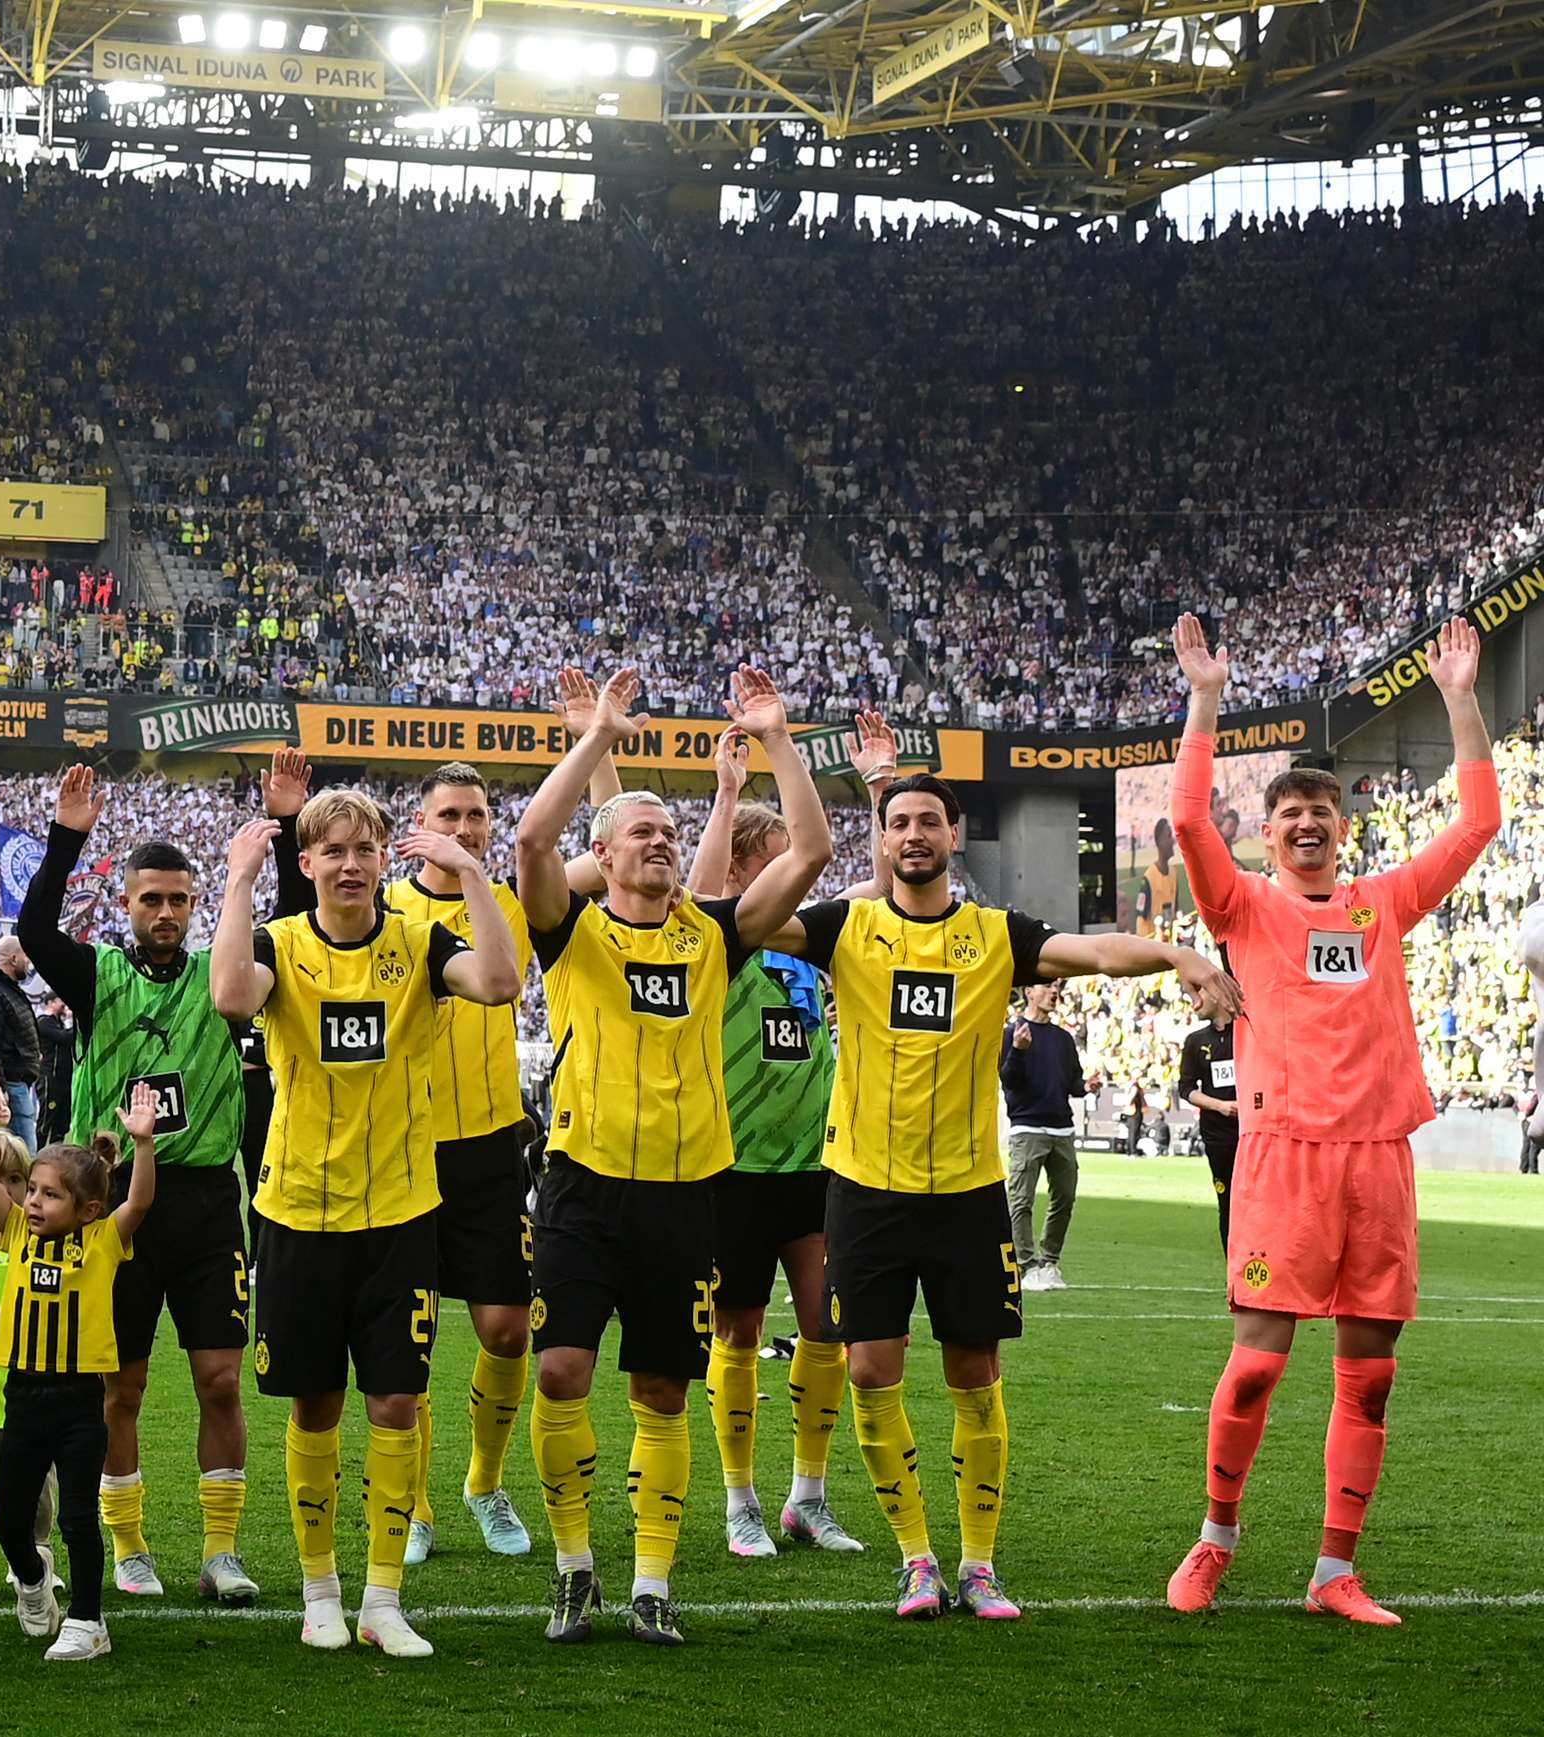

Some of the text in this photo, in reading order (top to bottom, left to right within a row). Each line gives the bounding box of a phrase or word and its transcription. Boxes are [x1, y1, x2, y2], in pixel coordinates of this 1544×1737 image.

[877, 18, 984, 91] SIGNAL IDUNA PARK
[103, 51, 377, 89] SIGNAL IDUNA PARK
[9, 499, 44, 520] 71
[326, 717, 749, 759] DIE NEUE BVB-EON 205
[1009, 719, 1306, 769] BORUSSIA DTMUND
[675, 935, 699, 953] BVB
[954, 944, 978, 960] BVB
[1313, 946, 1357, 972] 1&1
[380, 962, 406, 981] BVB
[629, 974, 680, 1006] 1&1
[897, 984, 947, 1017] 1&1
[326, 1016, 378, 1048] 1&1
[765, 1019, 802, 1048] 1&1
[1213, 1066, 1234, 1081] 1&1
[149, 1086, 179, 1120] &1
[33, 1267, 58, 1286] 1&1
[1000, 1242, 1019, 1294] 5
[1246, 1262, 1268, 1282] BVB
